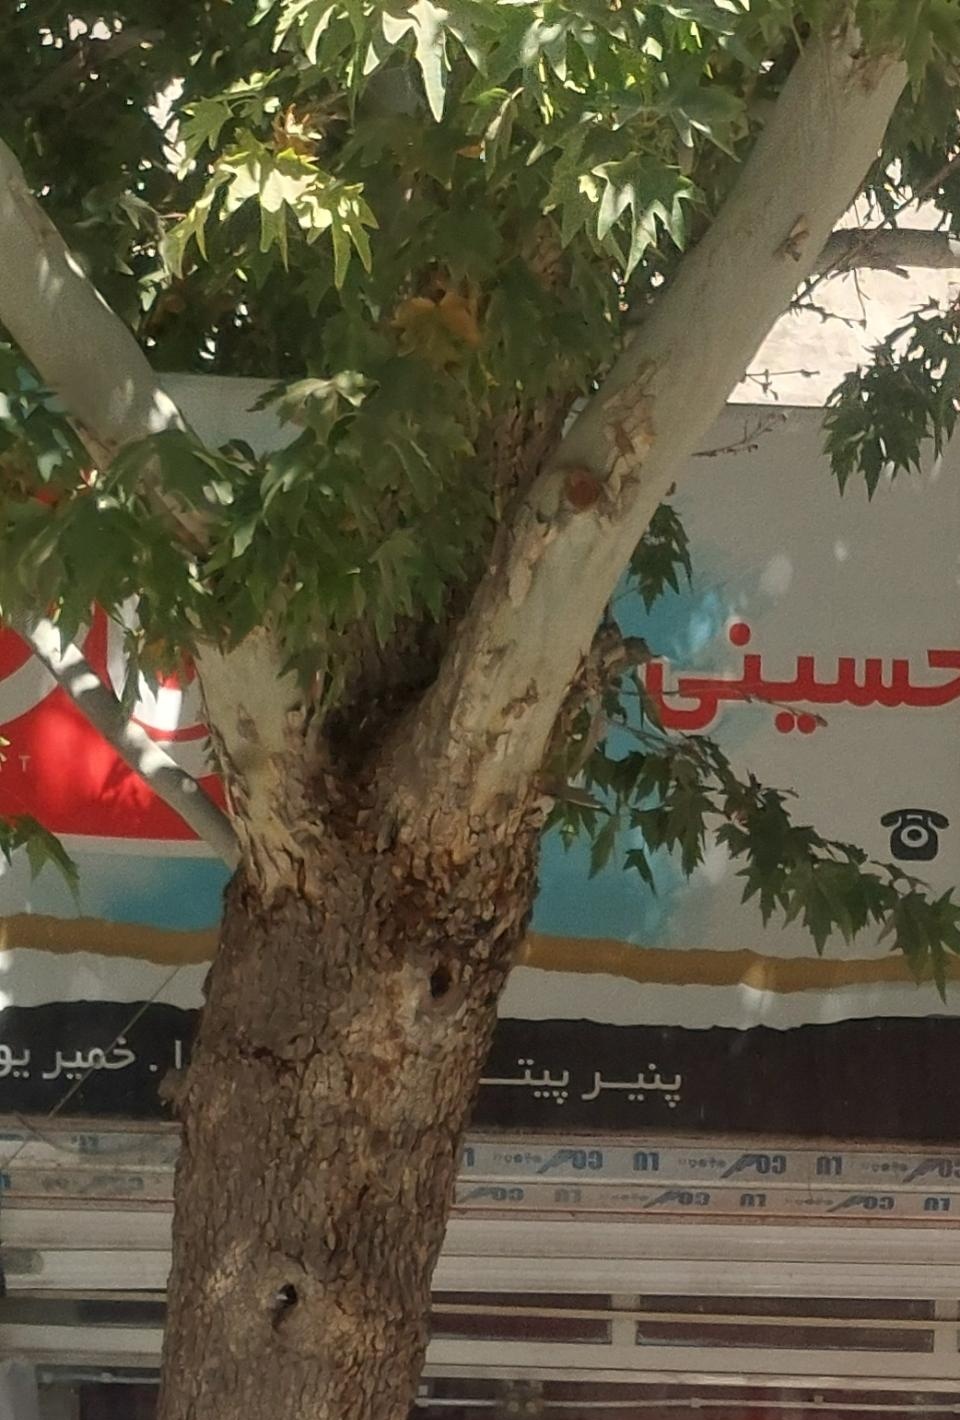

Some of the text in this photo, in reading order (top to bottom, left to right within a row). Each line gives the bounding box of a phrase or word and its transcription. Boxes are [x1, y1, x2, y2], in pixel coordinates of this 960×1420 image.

[42, 1035, 136, 1080] خمیر
[479, 1058, 682, 1108] پنیر پیت
